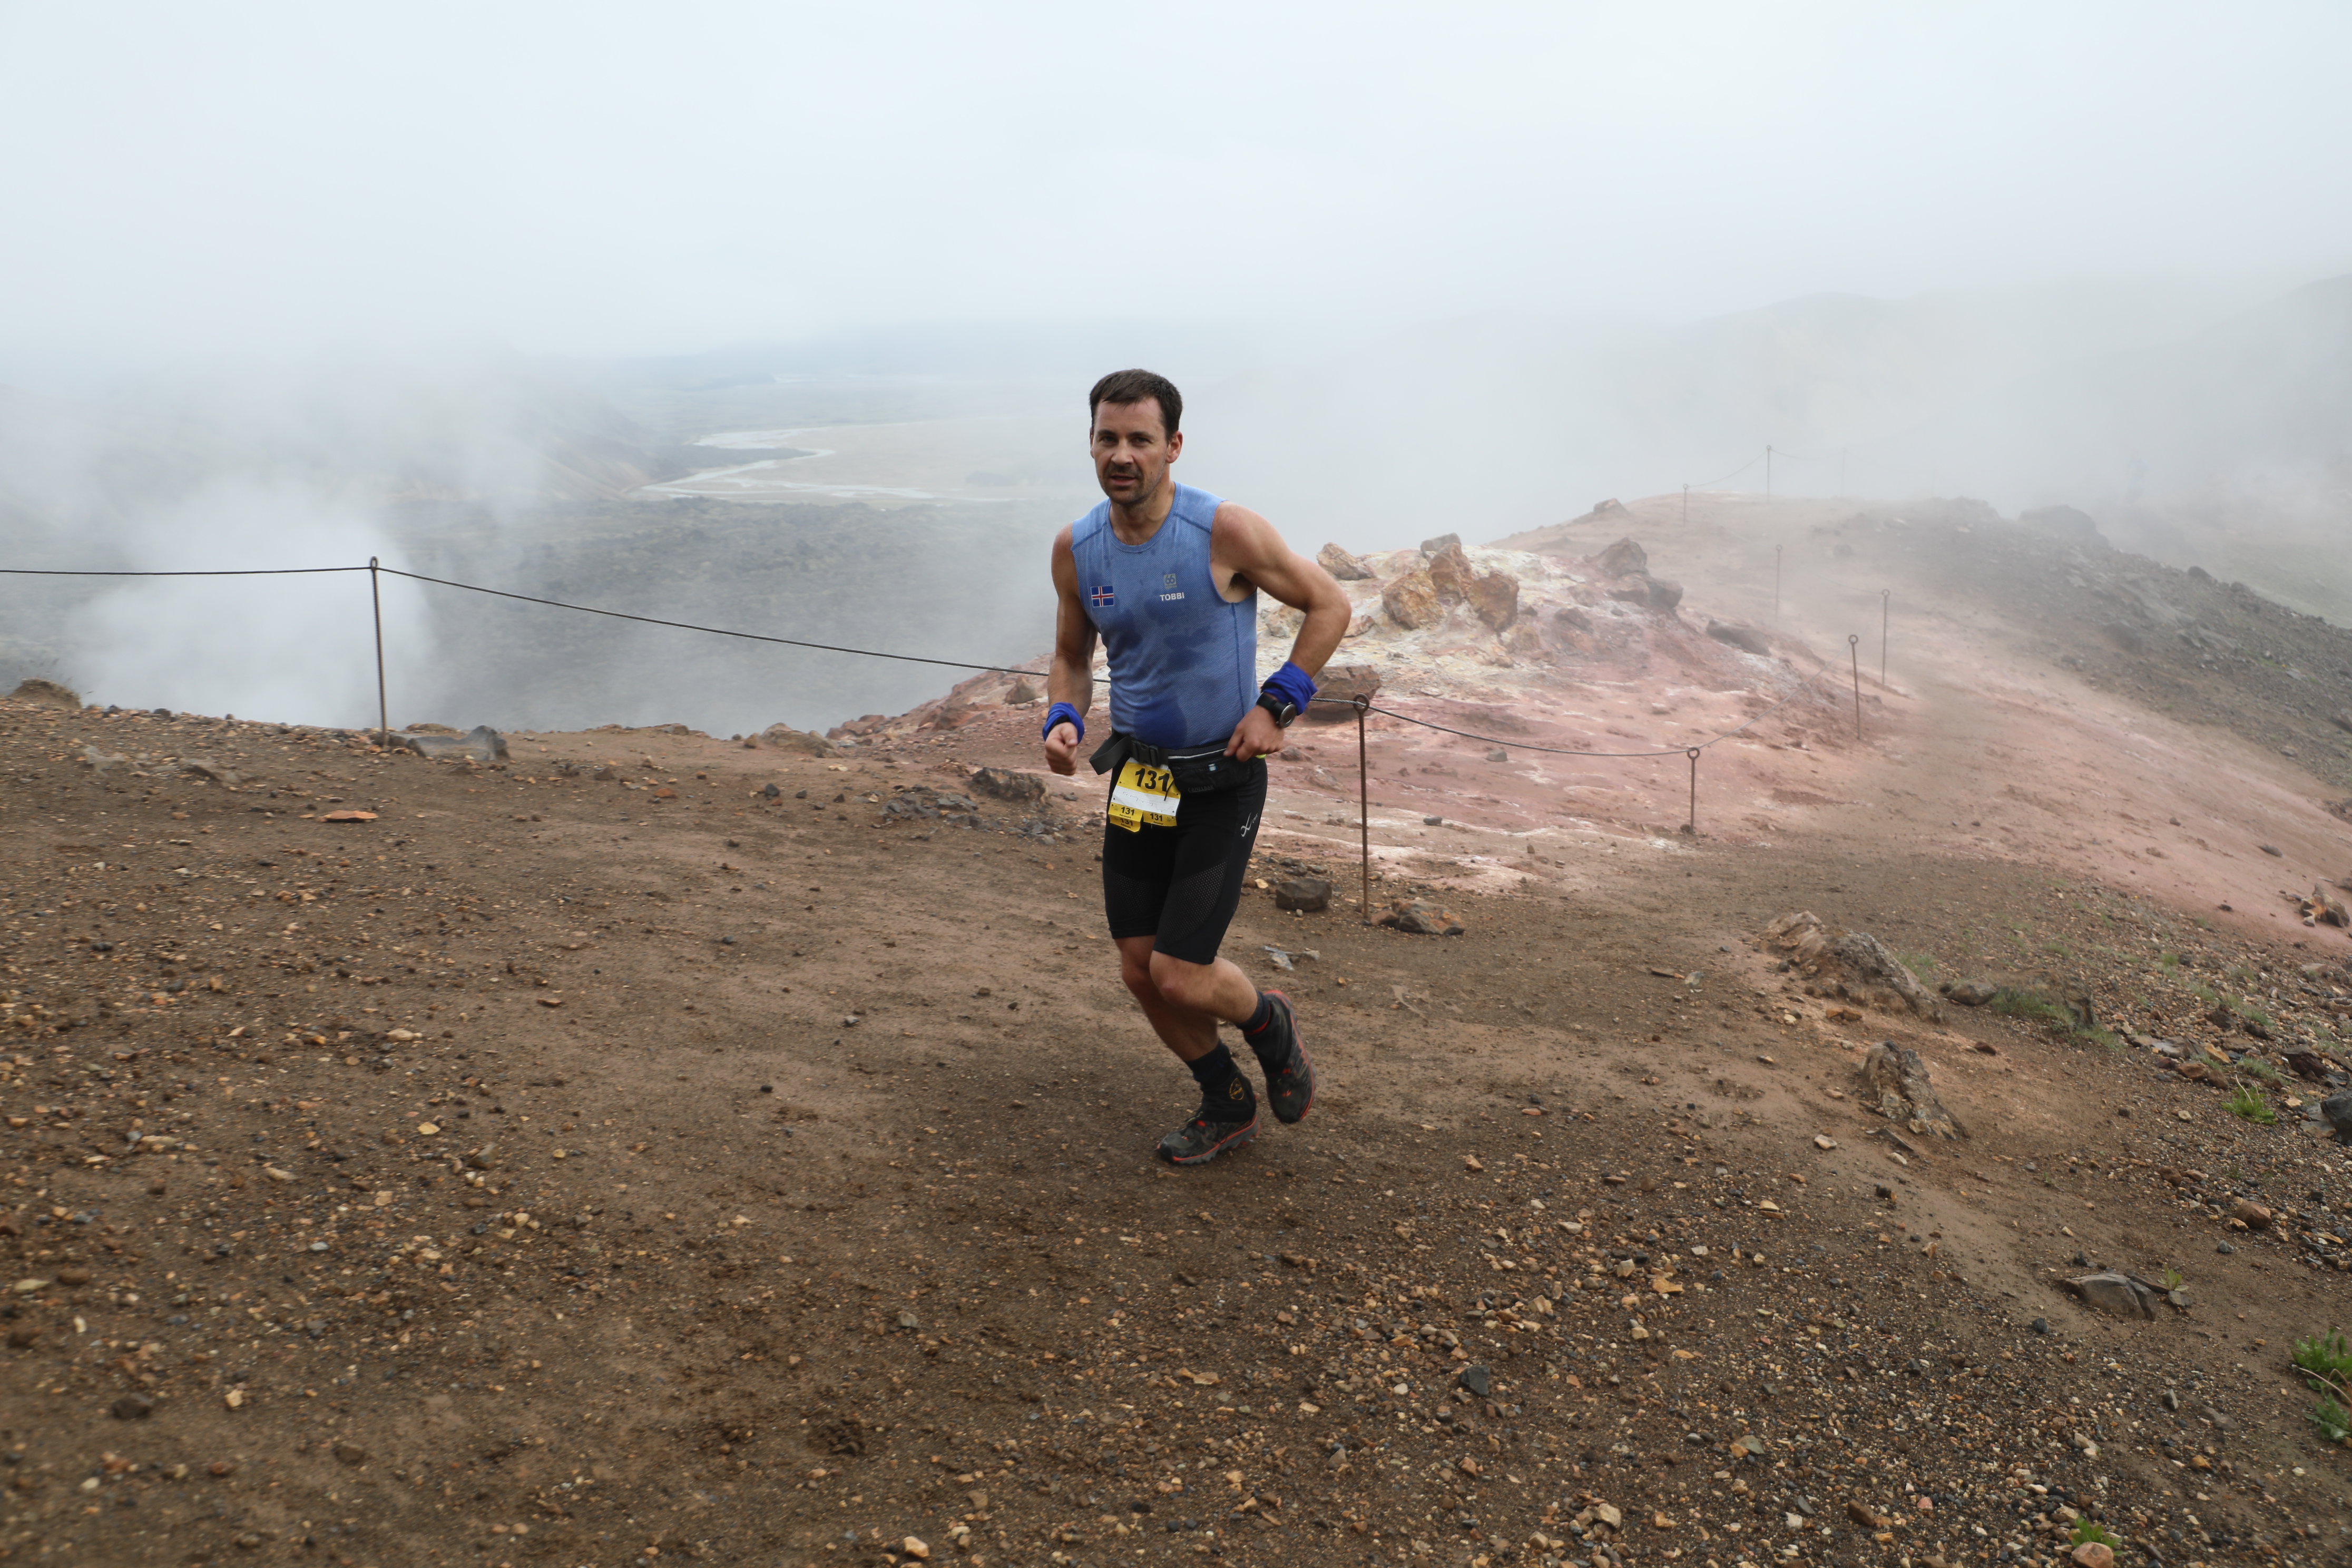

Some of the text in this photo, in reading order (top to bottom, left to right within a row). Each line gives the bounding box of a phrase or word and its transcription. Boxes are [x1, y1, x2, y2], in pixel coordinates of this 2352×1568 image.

[1160, 592, 1184, 601] TOBBI
[1135, 767, 1170, 792] 131
[1121, 807, 1135, 816] 131
[1150, 813, 1163, 822] 131
